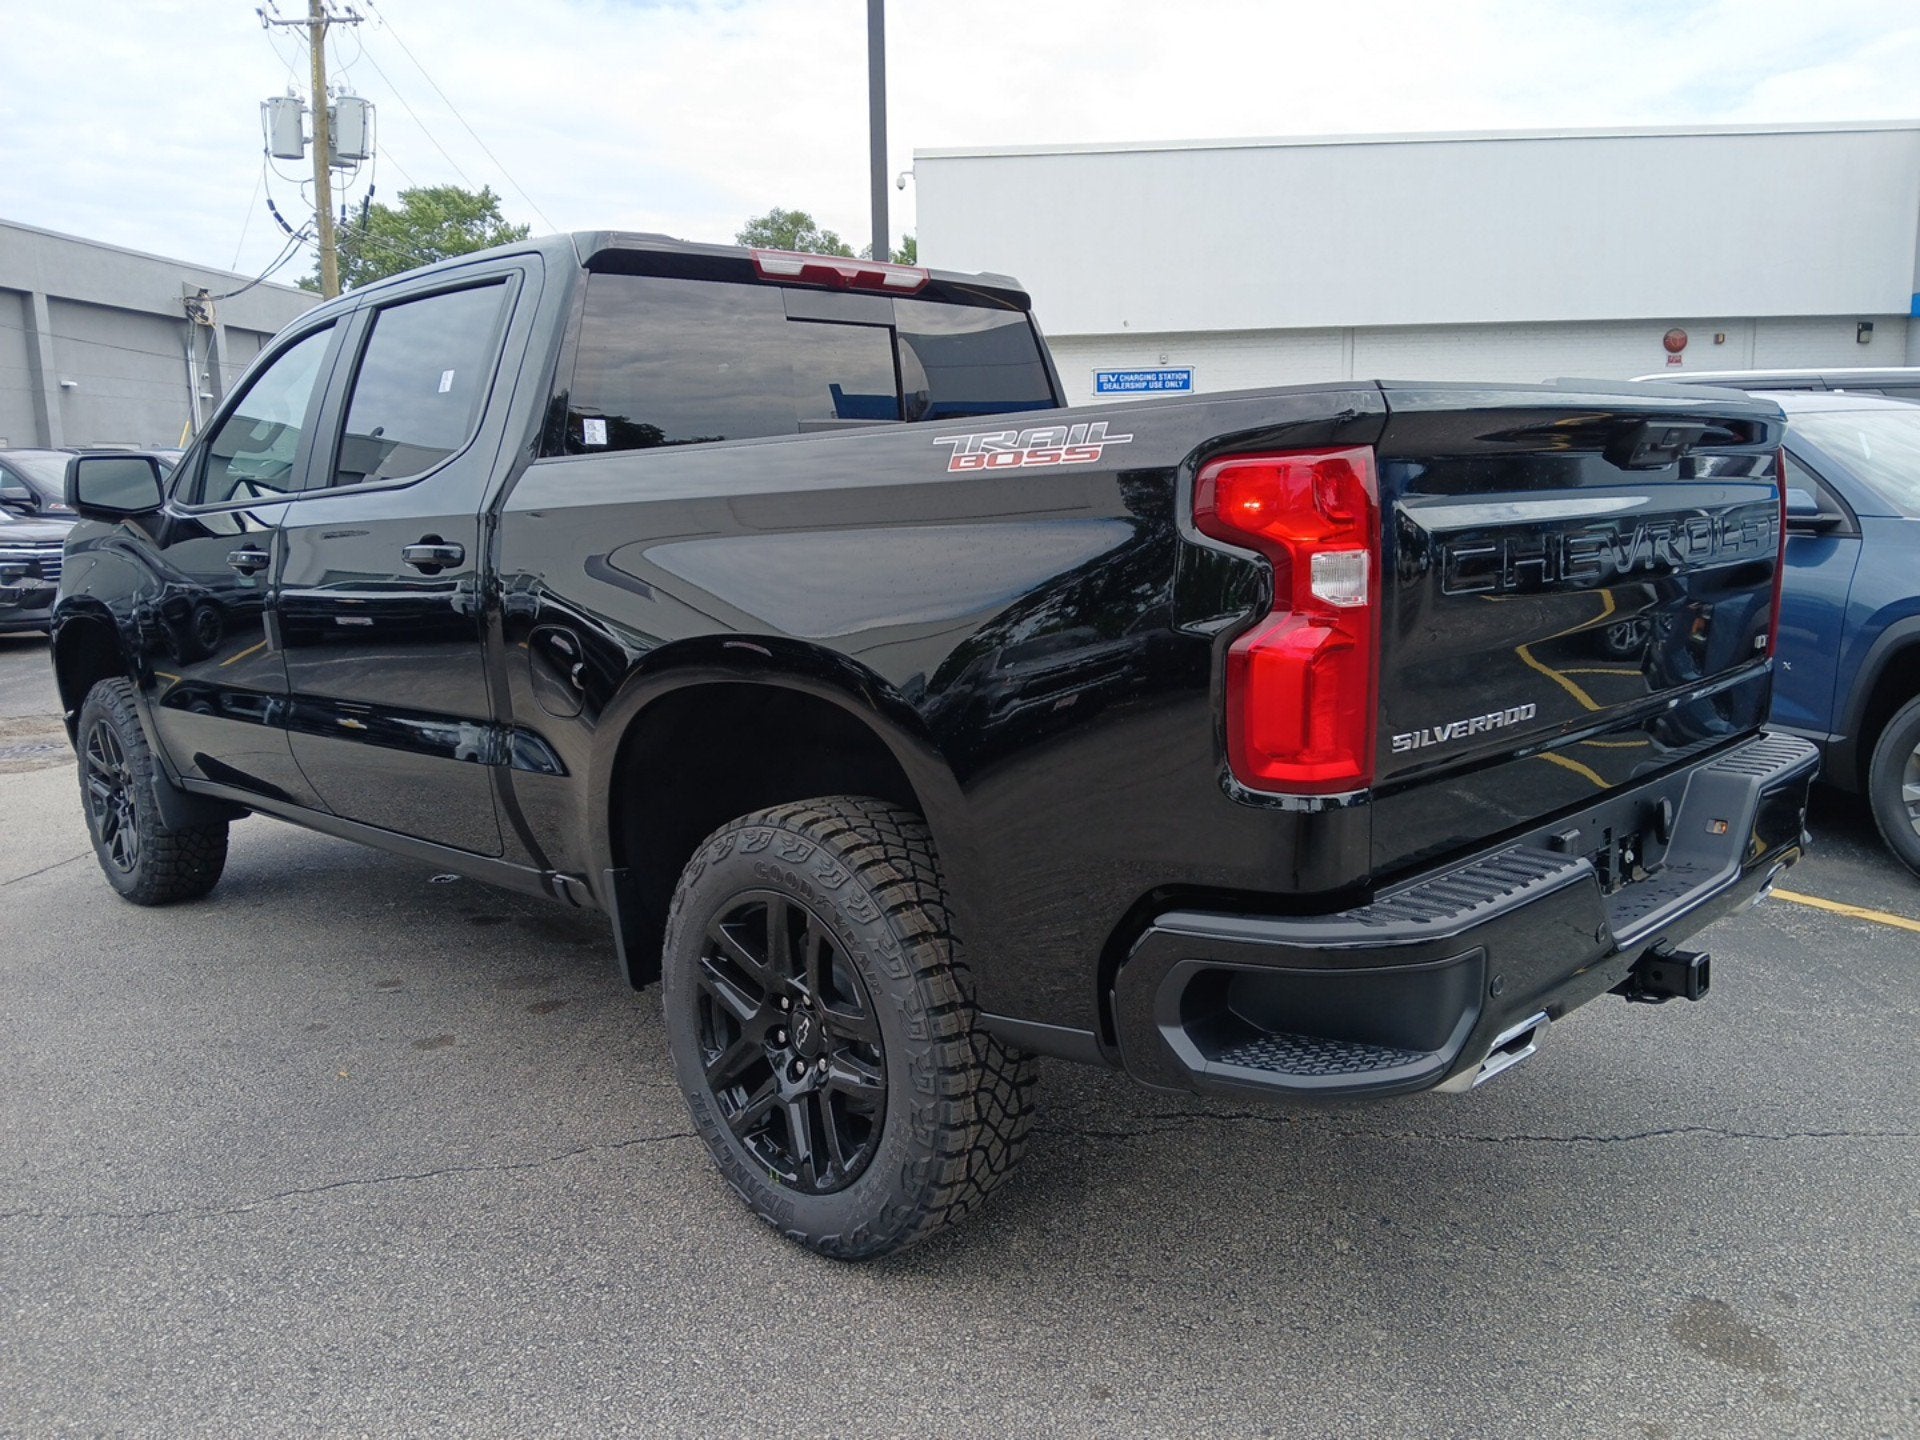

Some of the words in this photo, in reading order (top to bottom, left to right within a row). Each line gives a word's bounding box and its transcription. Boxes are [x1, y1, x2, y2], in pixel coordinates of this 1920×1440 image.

[1099, 374, 1118, 382] EV
[1120, 373, 1156, 382] CHARGING
[1159, 372, 1188, 381] STATION
[1103, 381, 1147, 390] DEALERSHIP
[1149, 381, 1163, 389] USE
[1165, 380, 1184, 389] ONLY
[933, 421, 1134, 456] TRAIL
[948, 444, 1102, 473] BOSS
[1391, 703, 1536, 753] SILVERADO
[753, 860, 884, 996] GOODYEAR
[690, 1090, 796, 1223] WRANGLER
